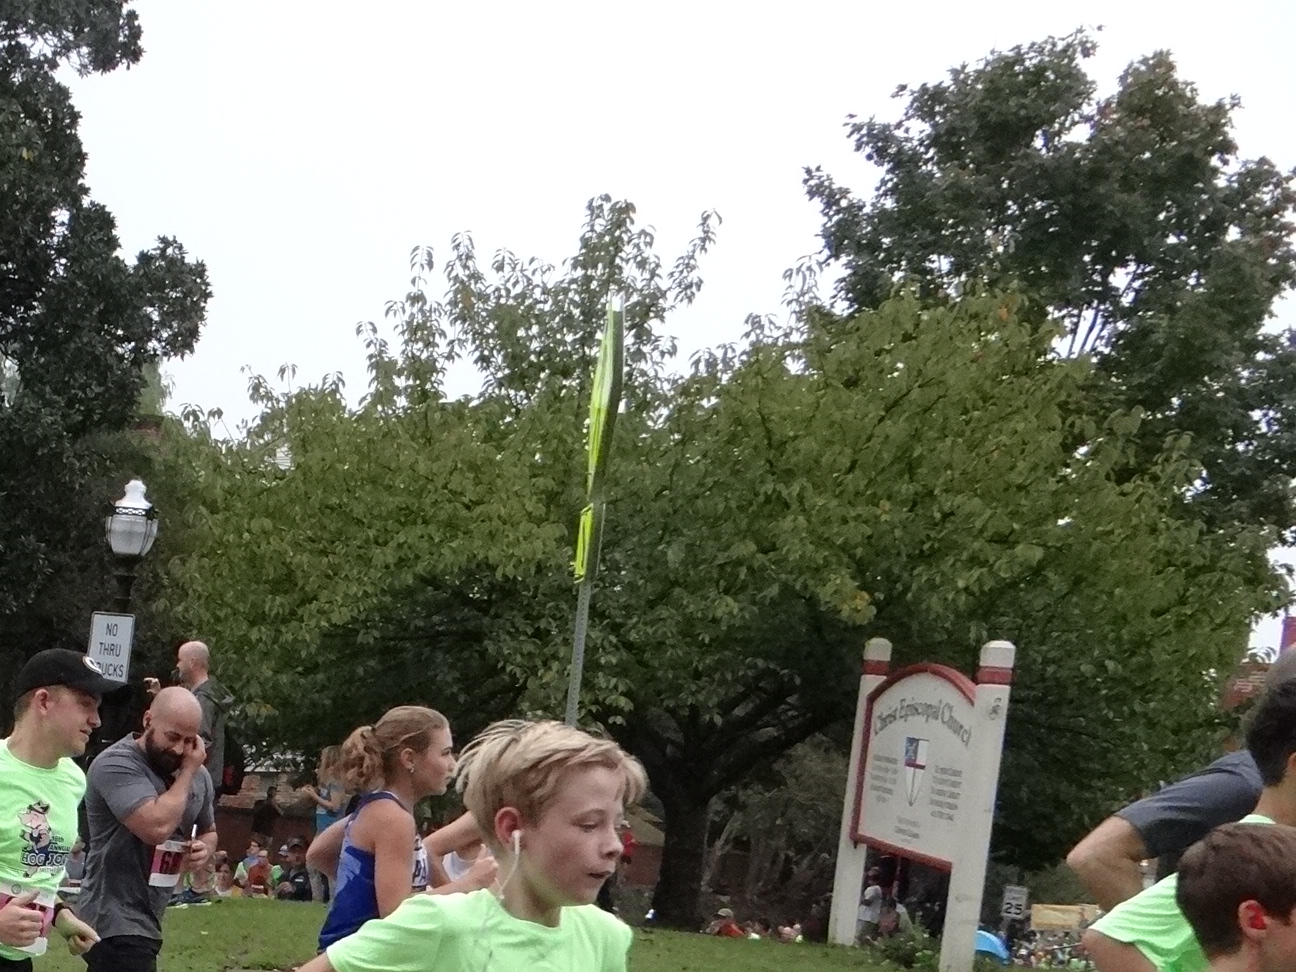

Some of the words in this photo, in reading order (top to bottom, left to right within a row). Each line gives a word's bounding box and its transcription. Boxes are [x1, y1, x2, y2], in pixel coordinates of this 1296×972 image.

[105, 623, 119, 637] NO
[99, 642, 122, 657] THRU
[96, 661, 124, 677] RUCKS
[21, 851, 46, 866] HOG
[1004, 902, 1024, 916] 25
